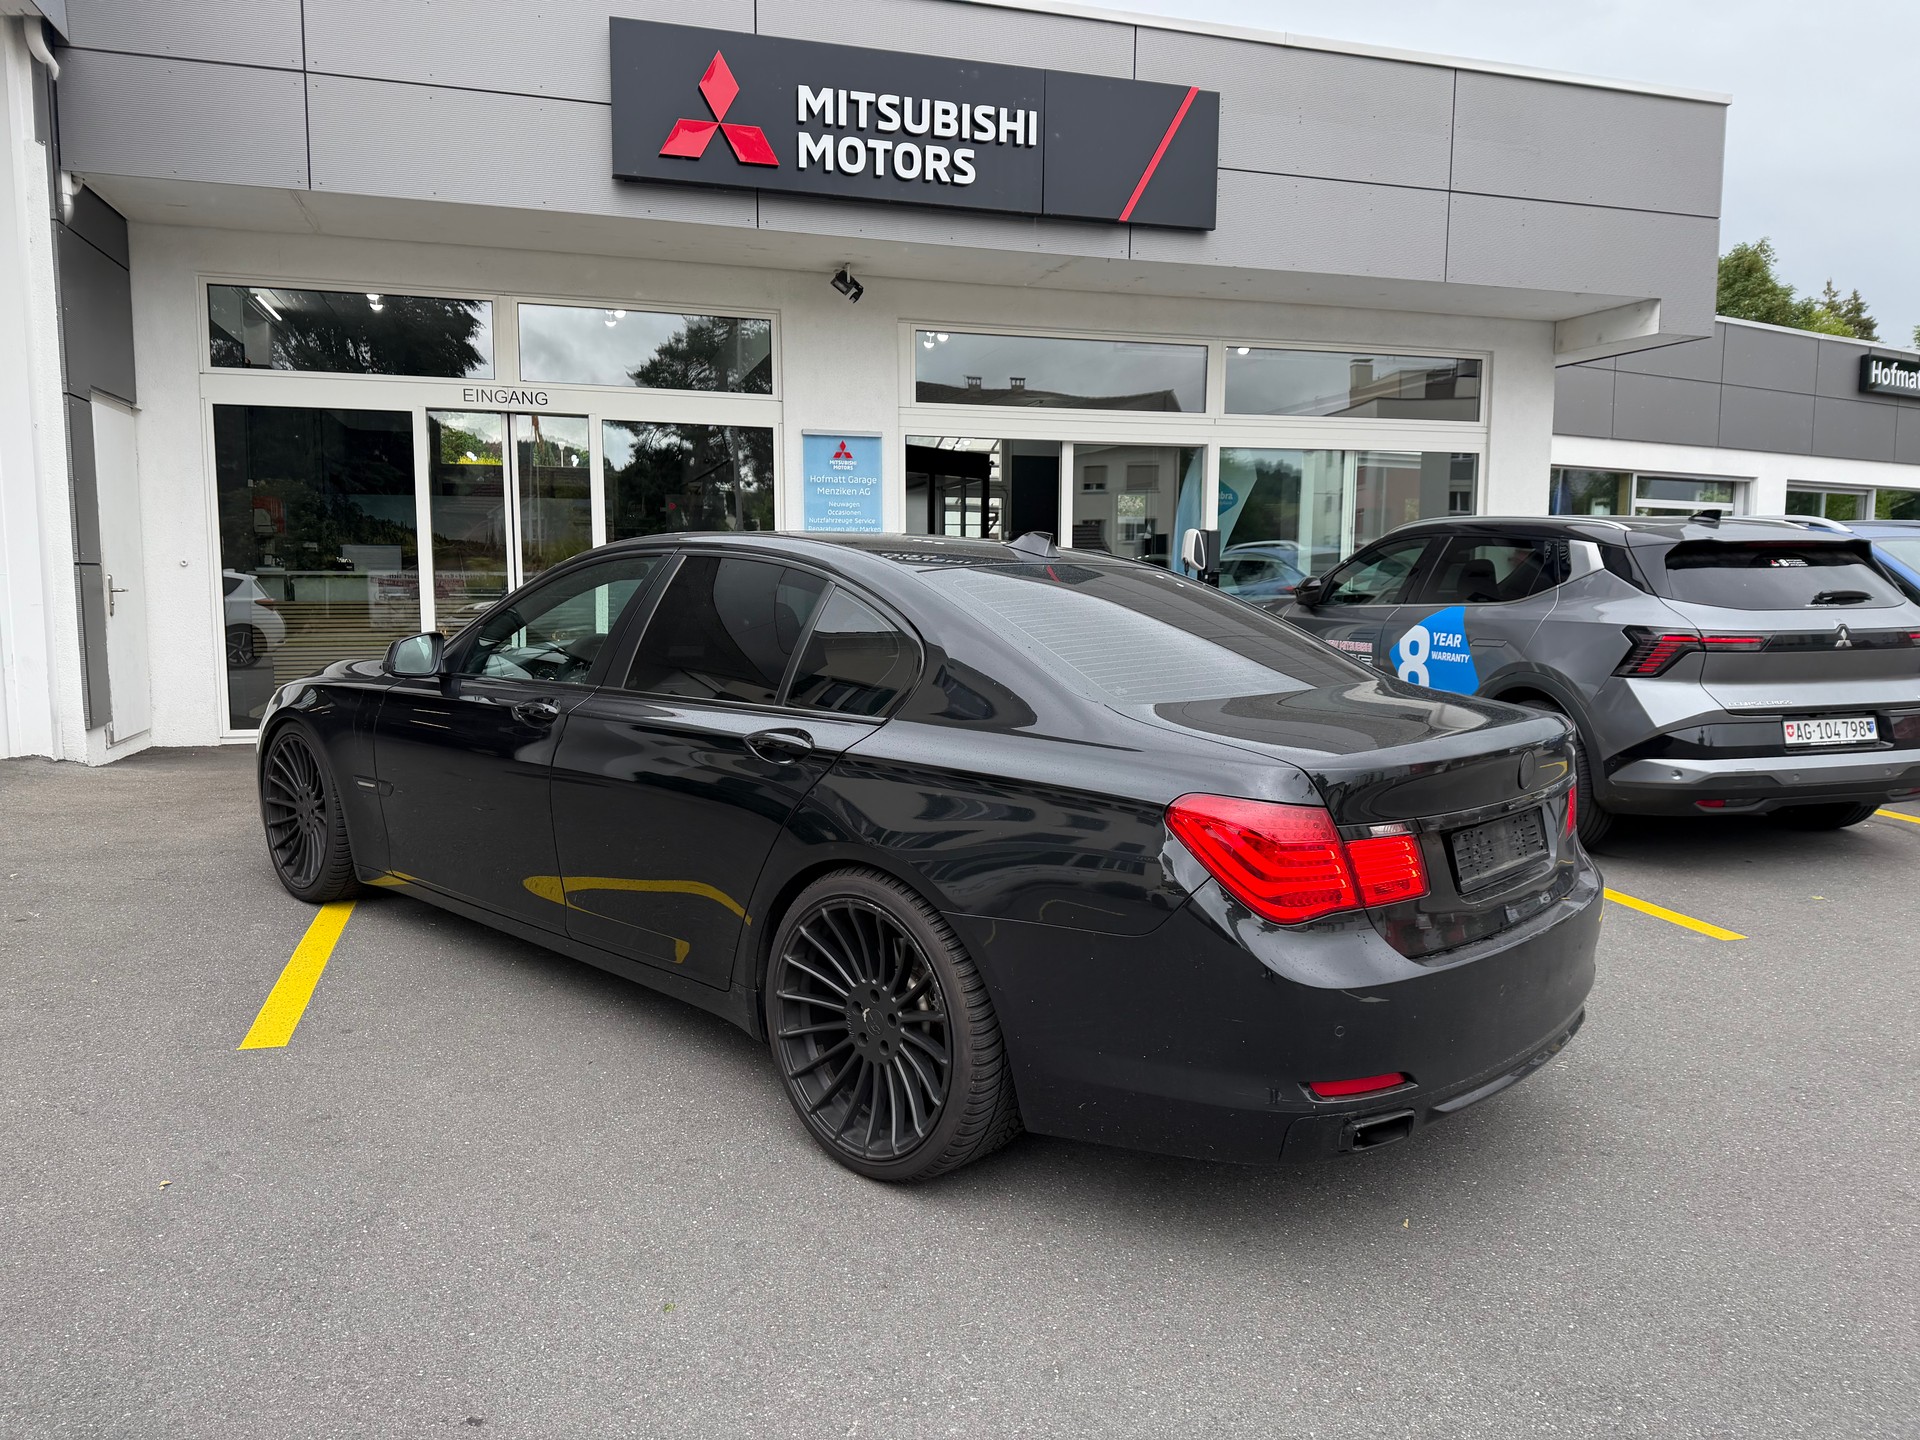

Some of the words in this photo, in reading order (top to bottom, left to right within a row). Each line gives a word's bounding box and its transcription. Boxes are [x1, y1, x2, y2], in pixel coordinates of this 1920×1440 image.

[798, 84, 1038, 146] MITSUBISHI
[798, 131, 976, 185] MOTORS
[463, 388, 548, 406] EINGANG
[809, 474, 846, 484] Hofmatt
[847, 475, 877, 486] Garage
[816, 487, 857, 495] Menziken
[858, 488, 871, 496] AG
[828, 501, 860, 509] Neuwagen
[808, 517, 853, 525] Nutzfahrzeuge
[854, 517, 876, 525] Service
[1433, 632, 1462, 648] YEAR
[1398, 624, 1431, 688] 8
[1431, 651, 1470, 664] WARRANTY
